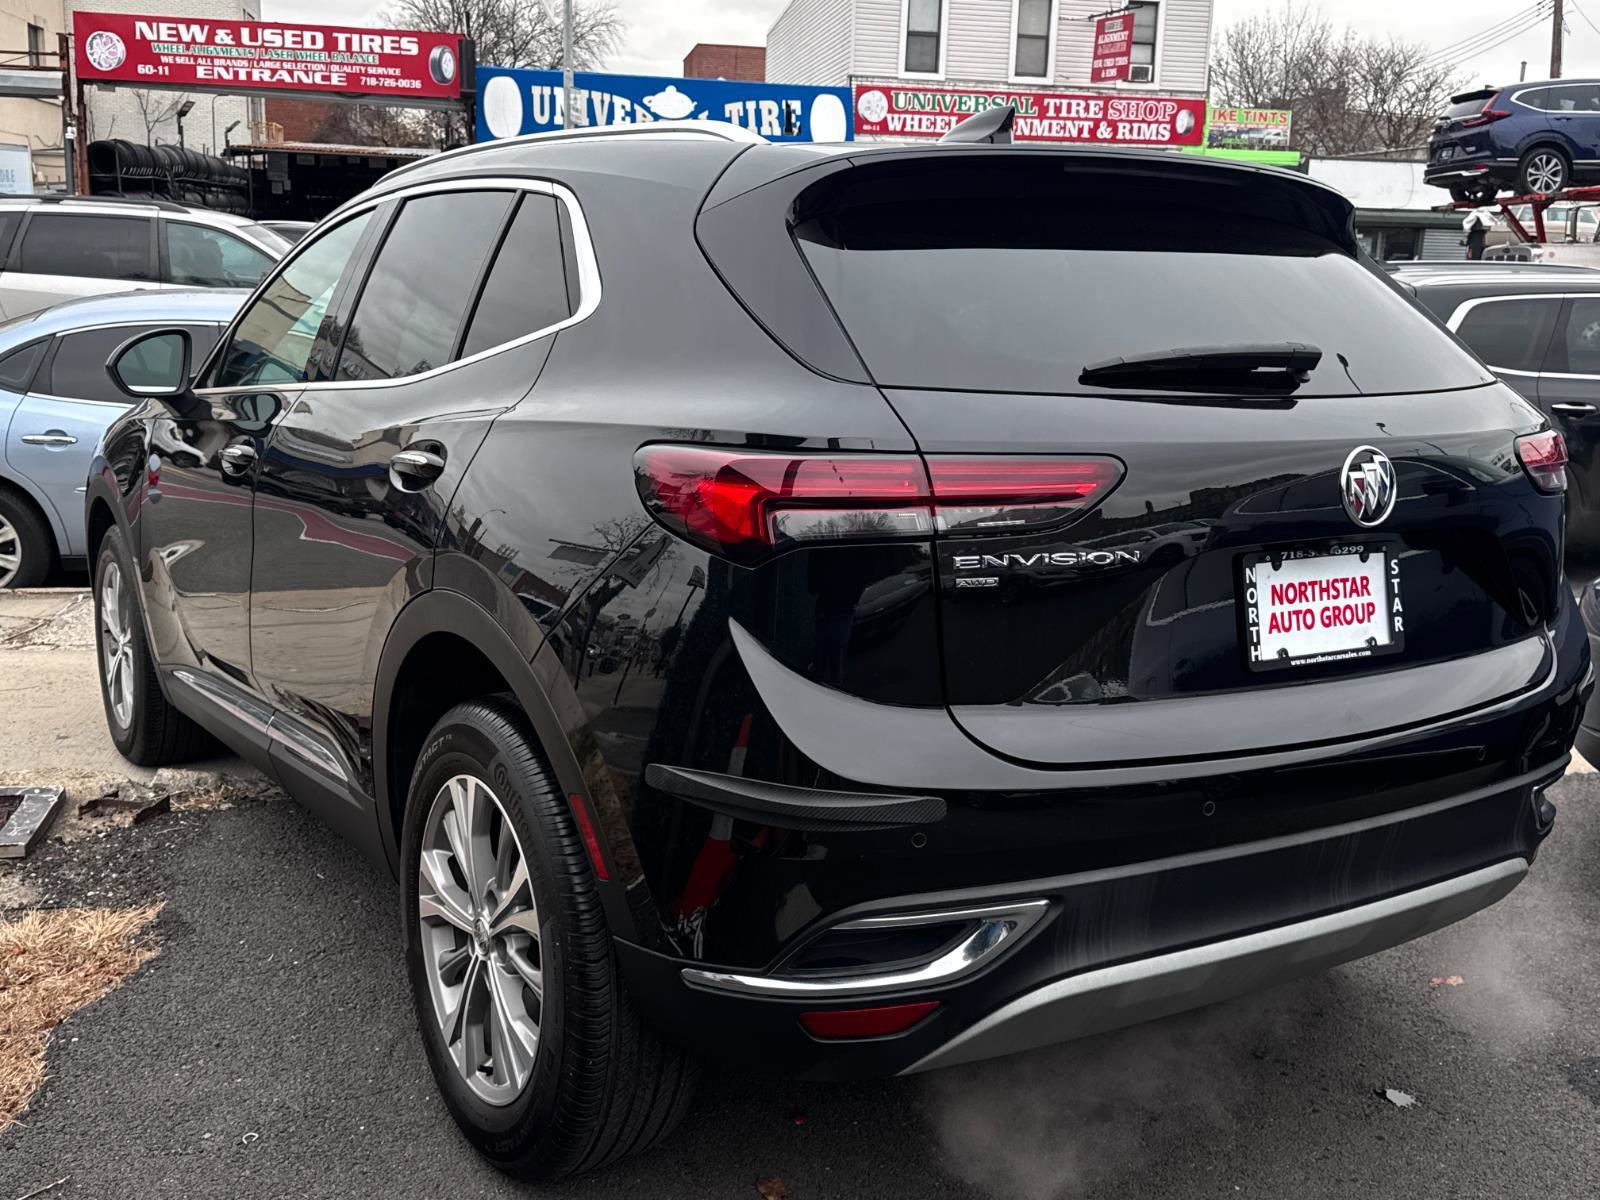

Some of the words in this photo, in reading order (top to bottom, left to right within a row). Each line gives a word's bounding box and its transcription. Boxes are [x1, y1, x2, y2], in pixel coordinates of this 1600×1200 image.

[135, 21, 209, 43] NEW
[214, 29, 236, 45] &
[240, 27, 324, 49] USED
[333, 33, 419, 55] TIRES
[151, 42, 188, 54] WHEEL
[188, 45, 254, 59] ALIGNMENTS
[260, 48, 295, 60] LASER
[296, 51, 330, 62] WHEEL
[331, 52, 379, 65] BALANCE
[137, 64, 169, 75] 60-11
[160, 55, 174, 64] WE
[175, 56, 195, 65] SELL
[197, 57, 213, 66] ALL
[214, 59, 249, 68] BRANDS
[254, 60, 282, 69] LARGE
[283, 62, 326, 71] SELECTION
[331, 64, 366, 74] QUALITY
[367, 66, 401, 76] SERVICE
[196, 66, 347, 86] ENTRANCE
[360, 76, 422, 89] 718-726-0036
[891, 91, 1038, 116] UNIVERSAL
[1043, 98, 1104, 119] TIRE
[1108, 100, 1177, 121] SHOP
[1243, 109, 1287, 124] TINTS
[724, 99, 802, 136] TIRE
[1096, 121, 1113, 139] &
[1116, 122, 1171, 141] RIMS
[953, 550, 1140, 568] ENVISION
[955, 577, 999, 588] AWD
[1271, 576, 1371, 606] NORTHSTAR
[1390, 559, 1404, 632] STAR
[1245, 567, 1262, 662] NORTH
[1268, 608, 1315, 634] AUTO
[1320, 602, 1376, 628] GROUP
